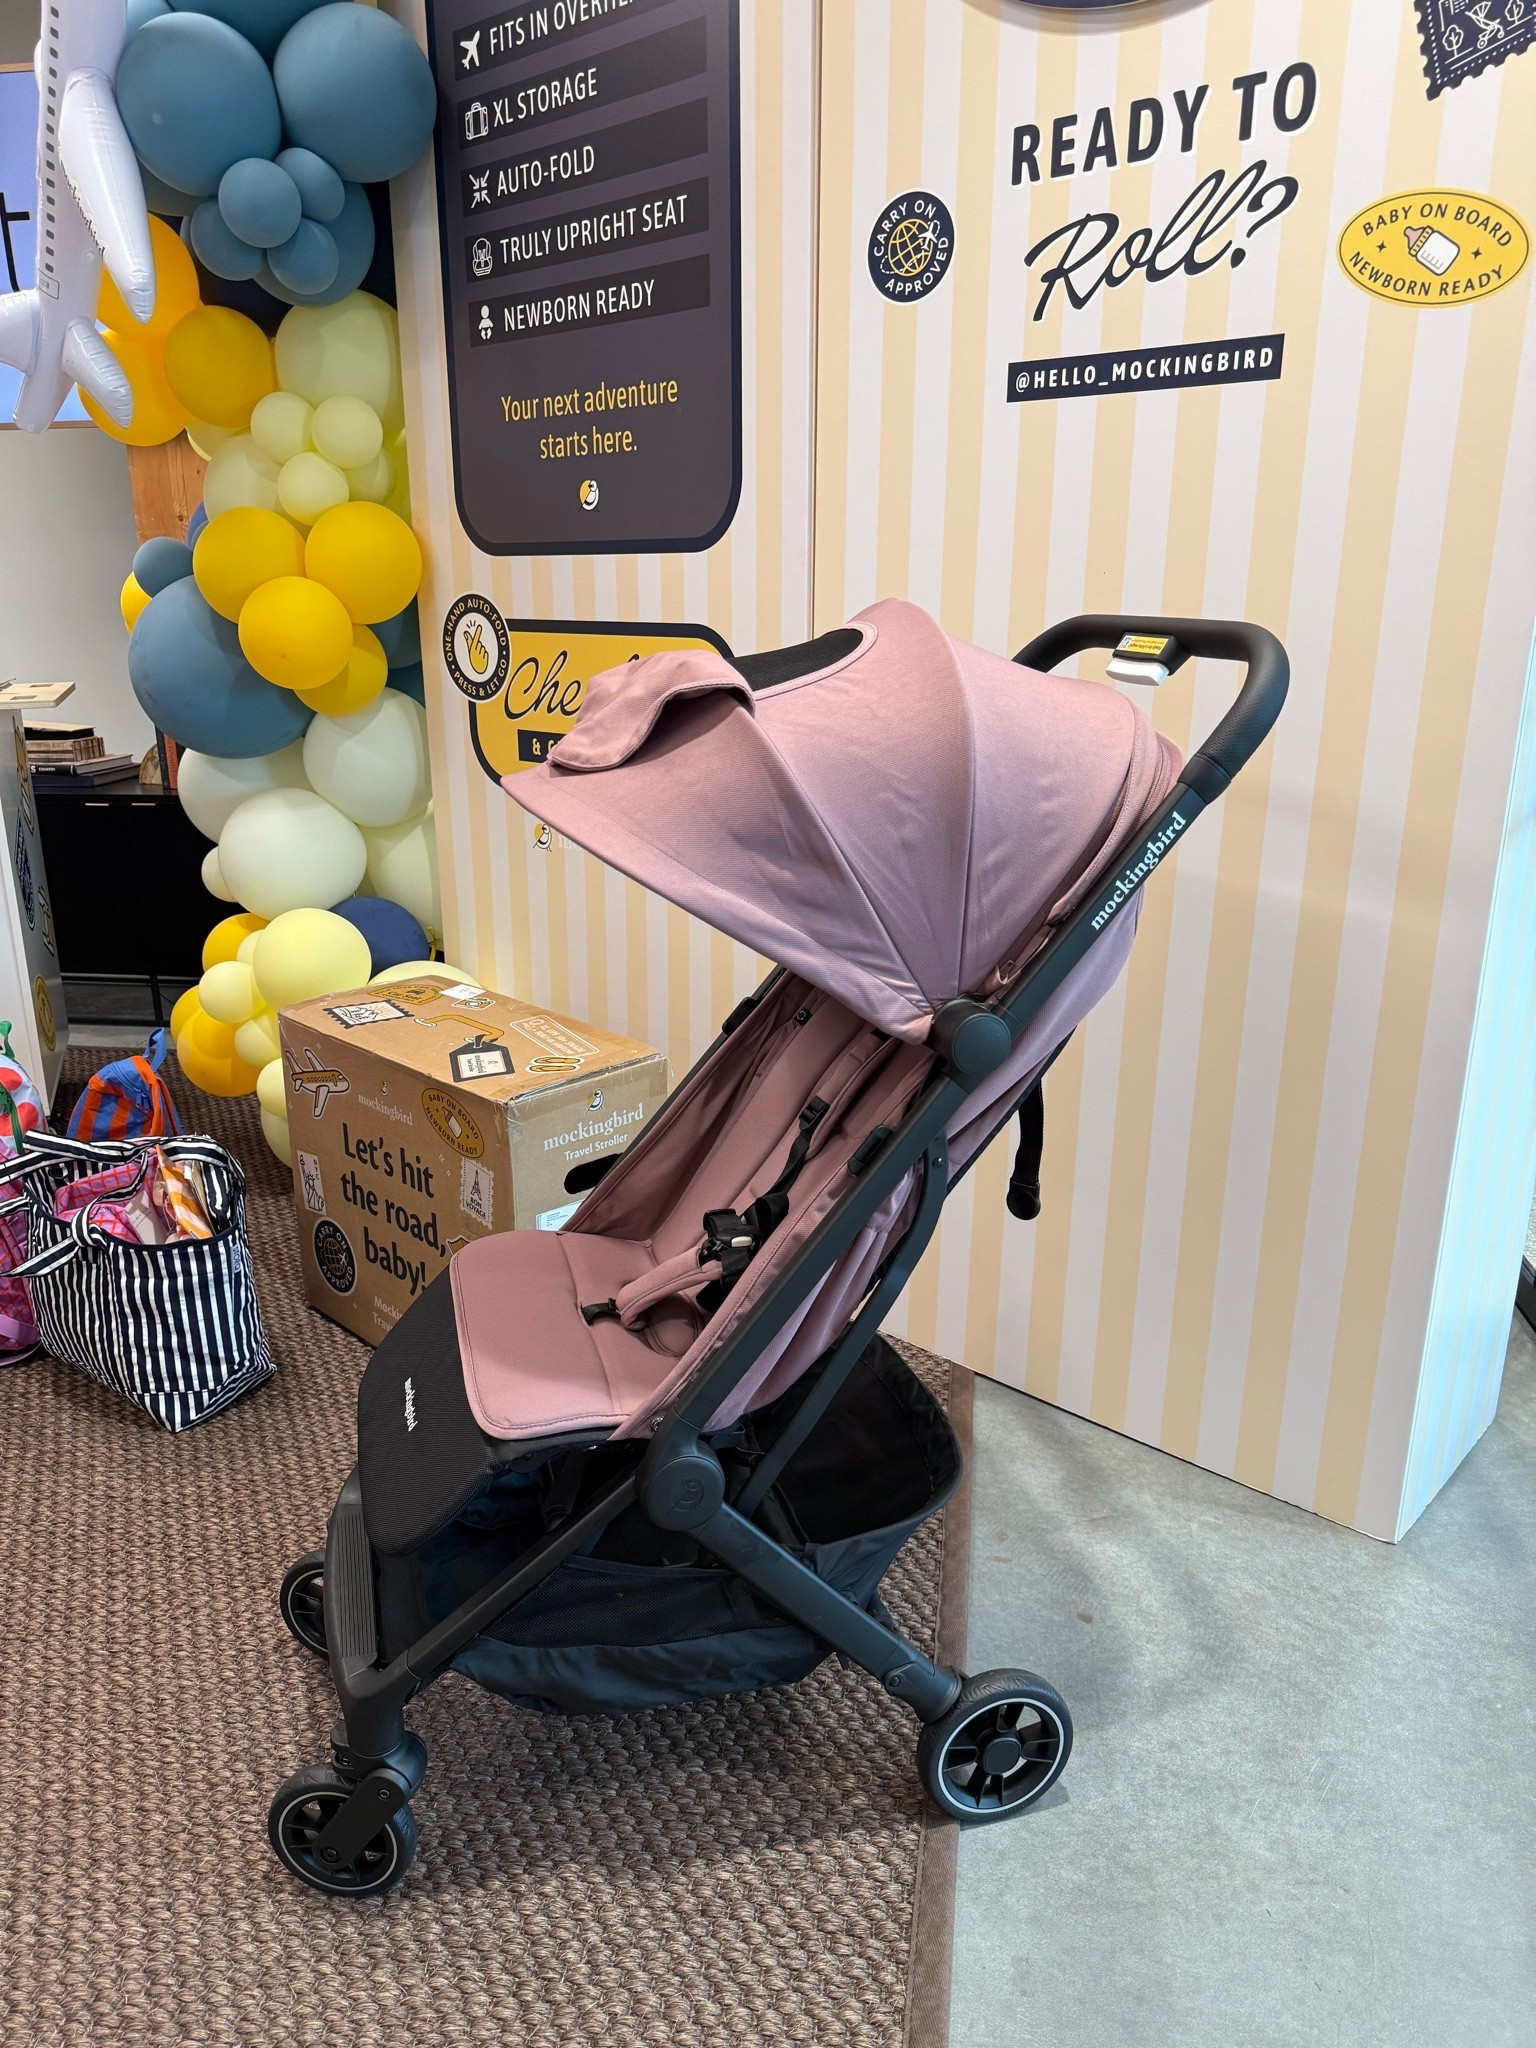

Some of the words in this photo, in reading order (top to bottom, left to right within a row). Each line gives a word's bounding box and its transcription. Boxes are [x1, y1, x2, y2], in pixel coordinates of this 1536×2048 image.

[489, 17, 525, 55] FITS
[530, 8, 548, 40] IN
[554, 0, 632, 31] OVER
[493, 98, 513, 127] XL
[516, 68, 598, 120] STORAGE
[1011, 84, 1210, 187] READY
[1231, 61, 1319, 142] TO
[497, 145, 595, 198] AUTO-FOLD
[500, 227, 551, 265] TRULY
[556, 208, 637, 254] UPRIGHT
[642, 195, 688, 233] SEAT
[874, 202, 907, 256] CARRY
[914, 200, 936, 219] ON
[1025, 159, 1300, 323] Roll?
[1362, 205, 1412, 236] BABY
[1420, 203, 1449, 218] ON
[1454, 206, 1512, 246] BOARD
[885, 237, 949, 295] APPROVED
[1349, 251, 1432, 296] NEWBORN
[1438, 264, 1503, 296] READY
[503, 292, 591, 332] NEWBORN
[597, 279, 655, 317] READY
[1015, 347, 1274, 393] @HELLO_MOCKINGBIRD
[501, 394, 539, 422] Your
[543, 388, 580, 417] next
[584, 378, 678, 413] adventure
[540, 431, 589, 460] starts
[593, 425, 638, 455] here.
[445, 602, 465, 662] ONE-HAND
[467, 598, 507, 646] AUTO-FOLD
[454, 671, 477, 696] PRESS
[479, 687, 485, 697] &
[487, 676, 500, 694] LET
[498, 659, 507, 677] GO
[504, 650, 639, 719] Che
[532, 738, 541, 755] &
[1090, 811, 1187, 931] mockingbird
[358, 1094, 413, 1126] mockingbird
[425, 1107, 455, 1146] NEWBORN
[457, 1140, 478, 1155] READY
[428, 1093, 444, 1105] BABY
[446, 1098, 456, 1111] ON
[457, 1109, 479, 1140] BOARD
[543, 1102, 644, 1151] mockingbird
[564, 1143, 593, 1161] Travel
[595, 1133, 628, 1151] Stroller
[400, 1147, 435, 1198] hit
[341, 1170, 379, 1216] the
[384, 1199, 446, 1258] road,
[465, 1200, 487, 1220] VOYAGE
[470, 1196, 482, 1209] BON
[318, 1224, 334, 1247] CARRY
[335, 1232, 348, 1250] ON
[363, 1226, 426, 1296] baby!
[321, 1265, 354, 1288] APPROVED
[372, 1311, 394, 1332] Trav
